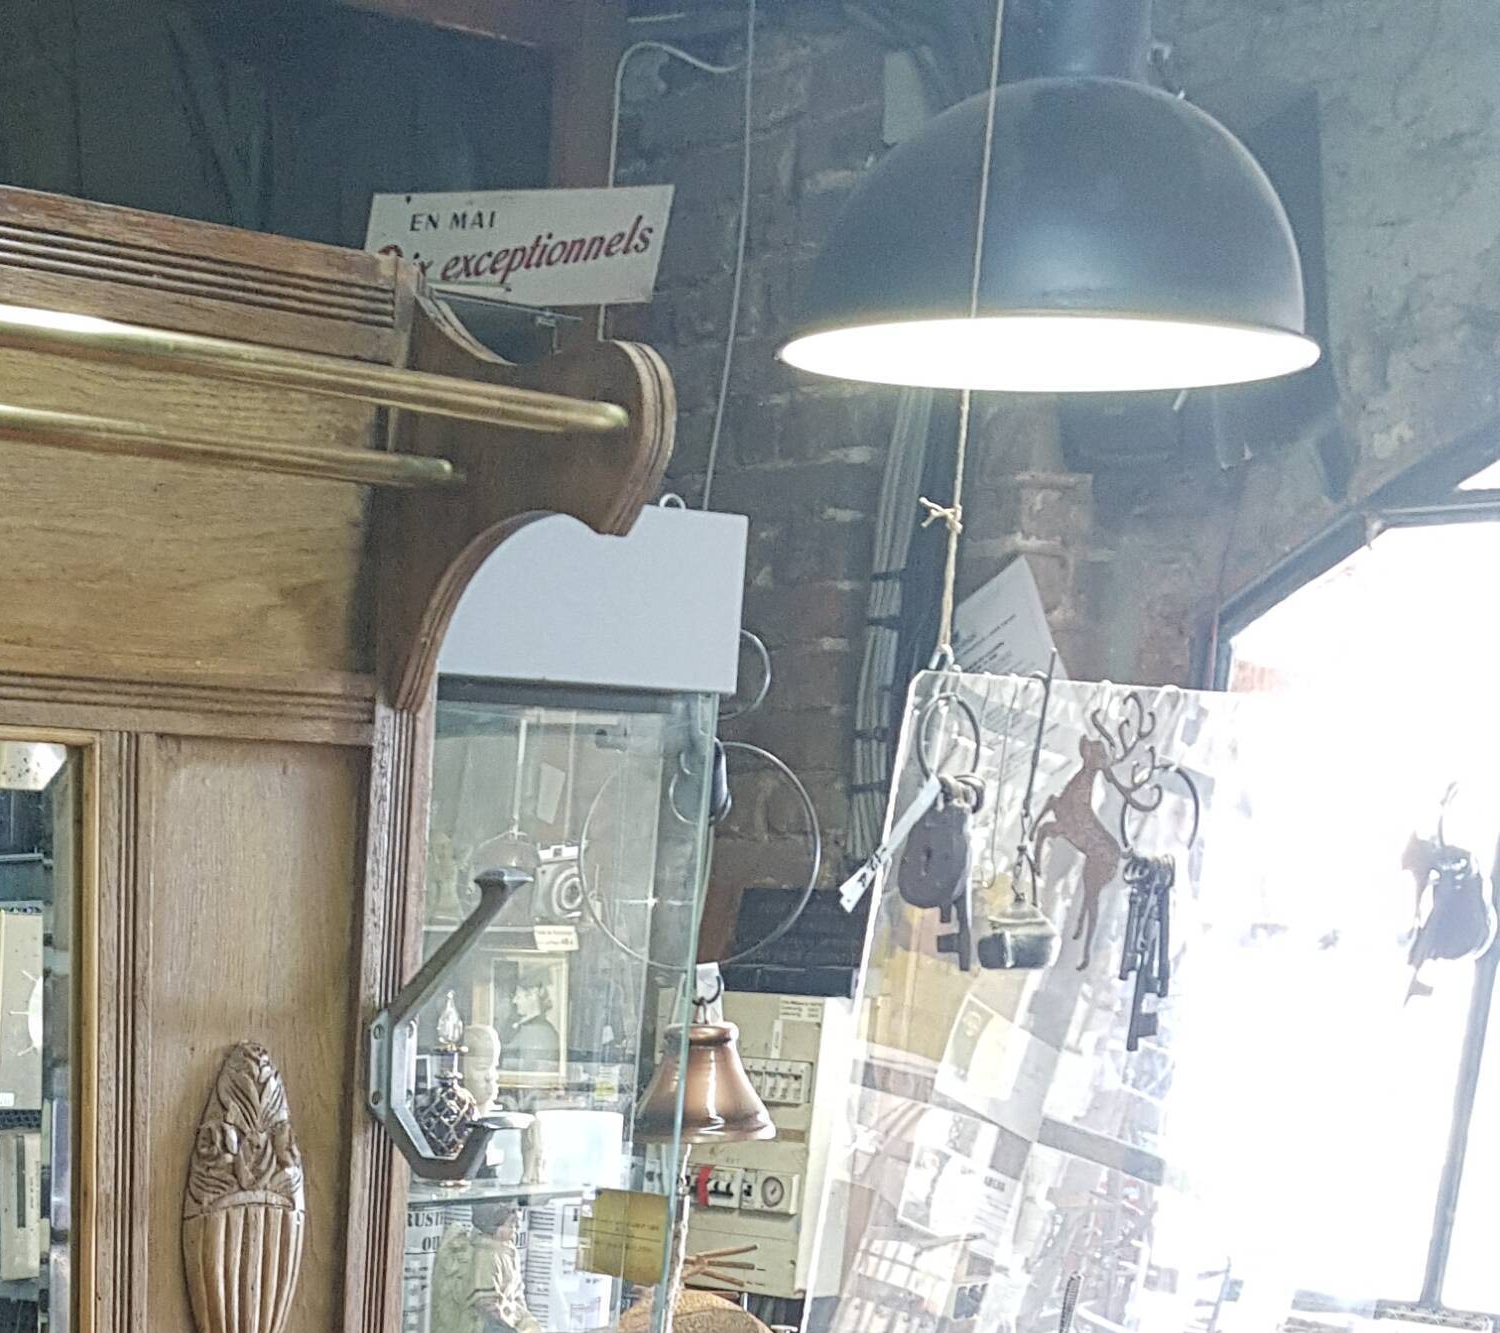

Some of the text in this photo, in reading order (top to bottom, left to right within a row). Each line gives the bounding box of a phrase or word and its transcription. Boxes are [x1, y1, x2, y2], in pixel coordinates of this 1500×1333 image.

[409, 210, 497, 232] EN MAI
[441, 214, 653, 284] exceptionnels
